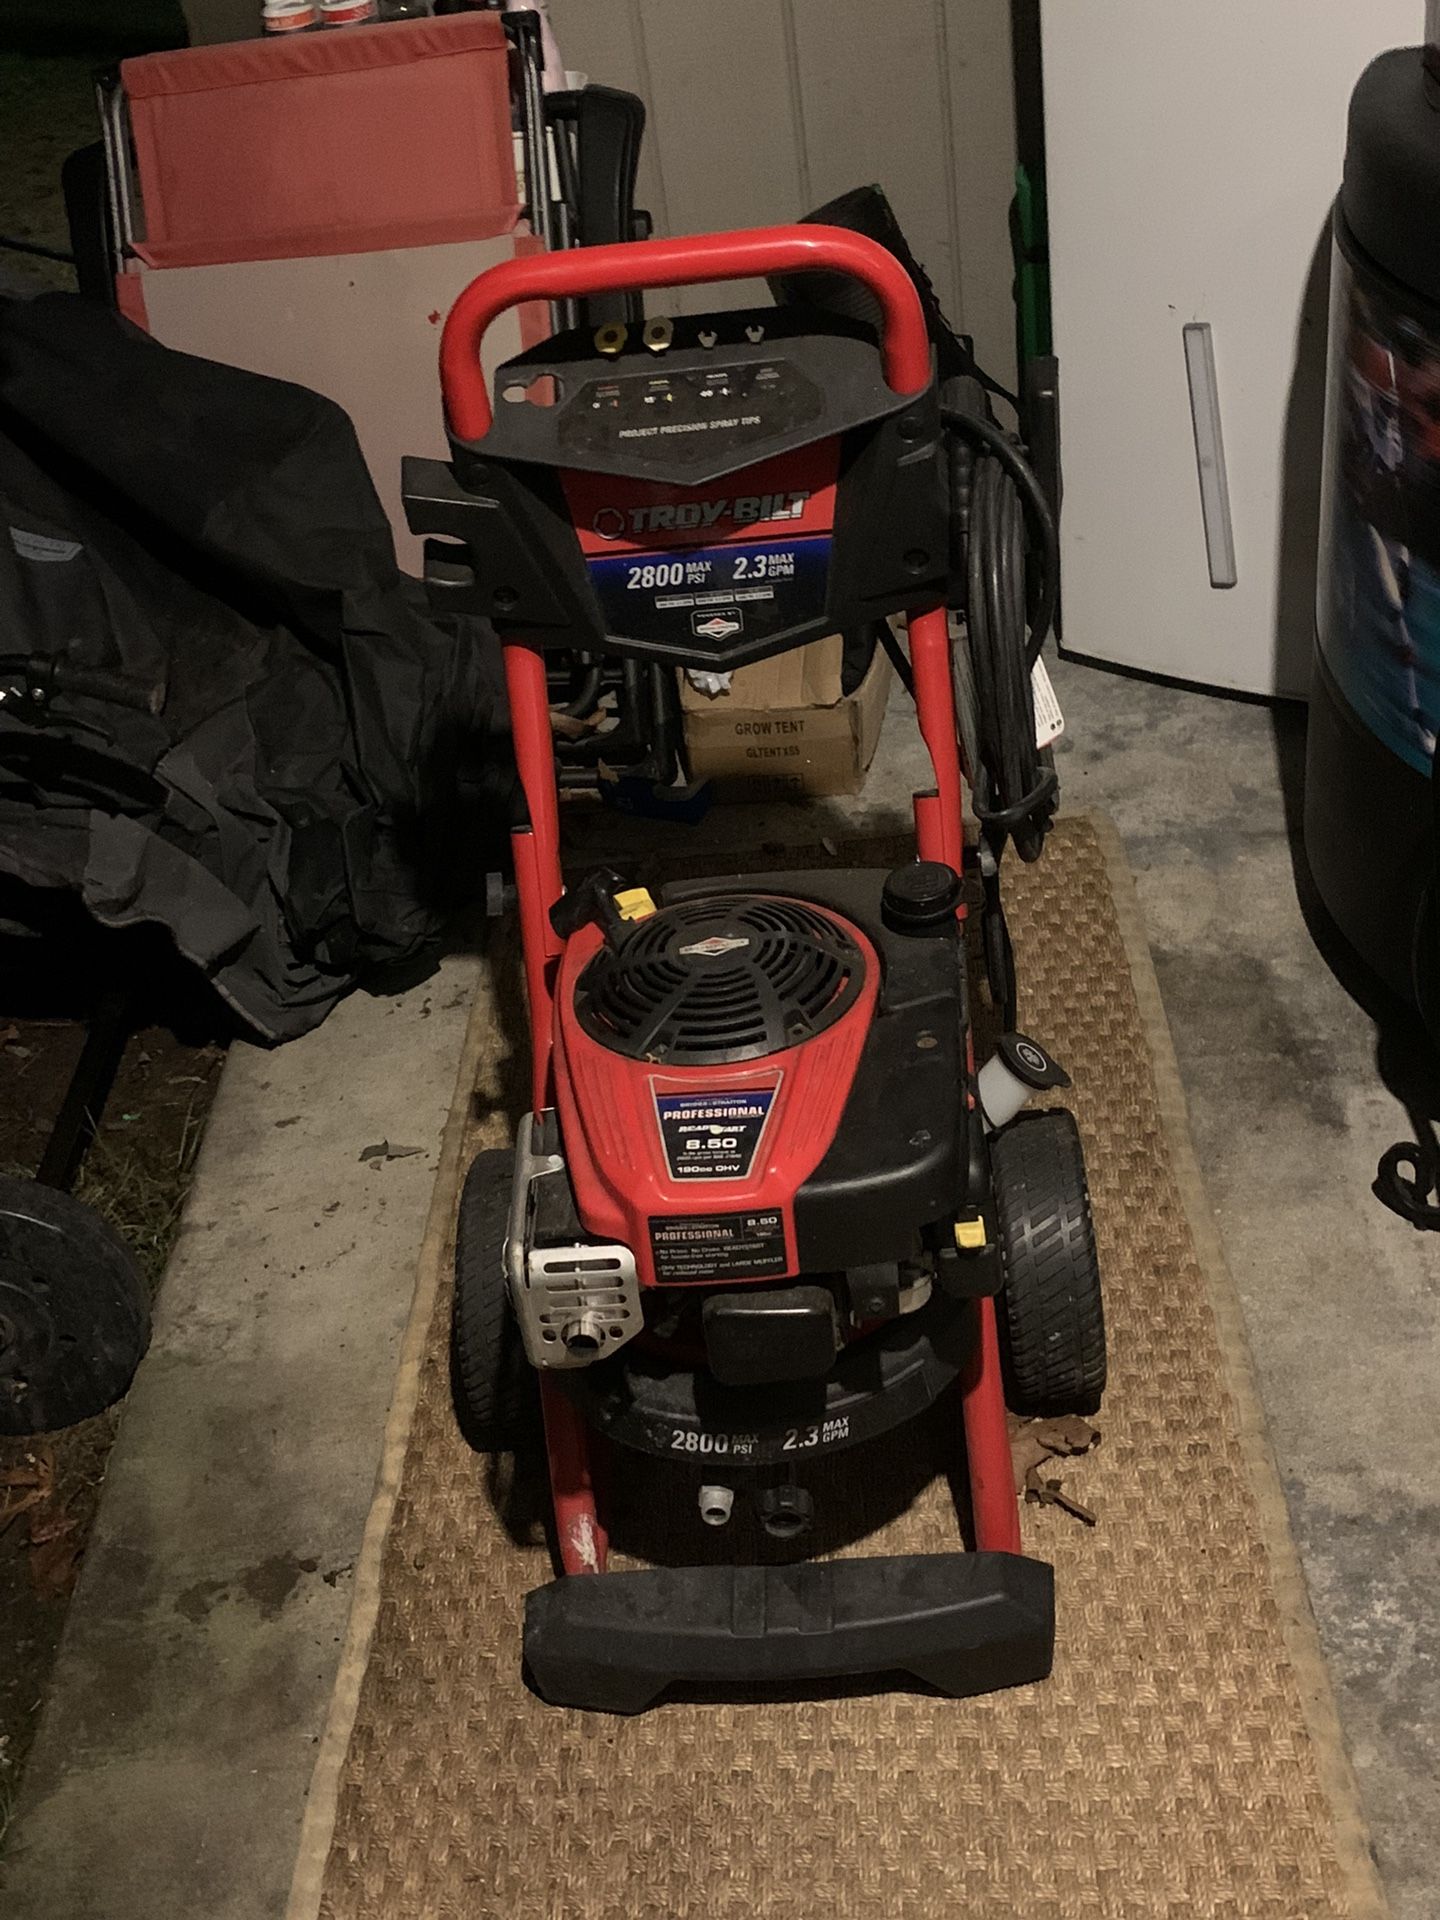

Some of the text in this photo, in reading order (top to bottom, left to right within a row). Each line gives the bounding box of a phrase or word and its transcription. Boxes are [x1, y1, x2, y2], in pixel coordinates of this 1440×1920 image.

[619, 416, 761, 438] PROJECT PRECISION SPRAY TIPS
[628, 491, 810, 533] TROY-BILT
[626, 561, 711, 589] 2800 MAX PSI
[732, 552, 795, 580] 2.3 MAX GPM
[735, 720, 805, 736] GROW TENT
[663, 1106, 765, 1120] PROFESSIONAL
[685, 1138, 738, 1150] 8.50
[655, 1229, 734, 1240] PROFESSIONAL
[671, 1429, 760, 1455] 2800 MAX PSI
[783, 1416, 850, 1450] 2.3 MAX GPM
